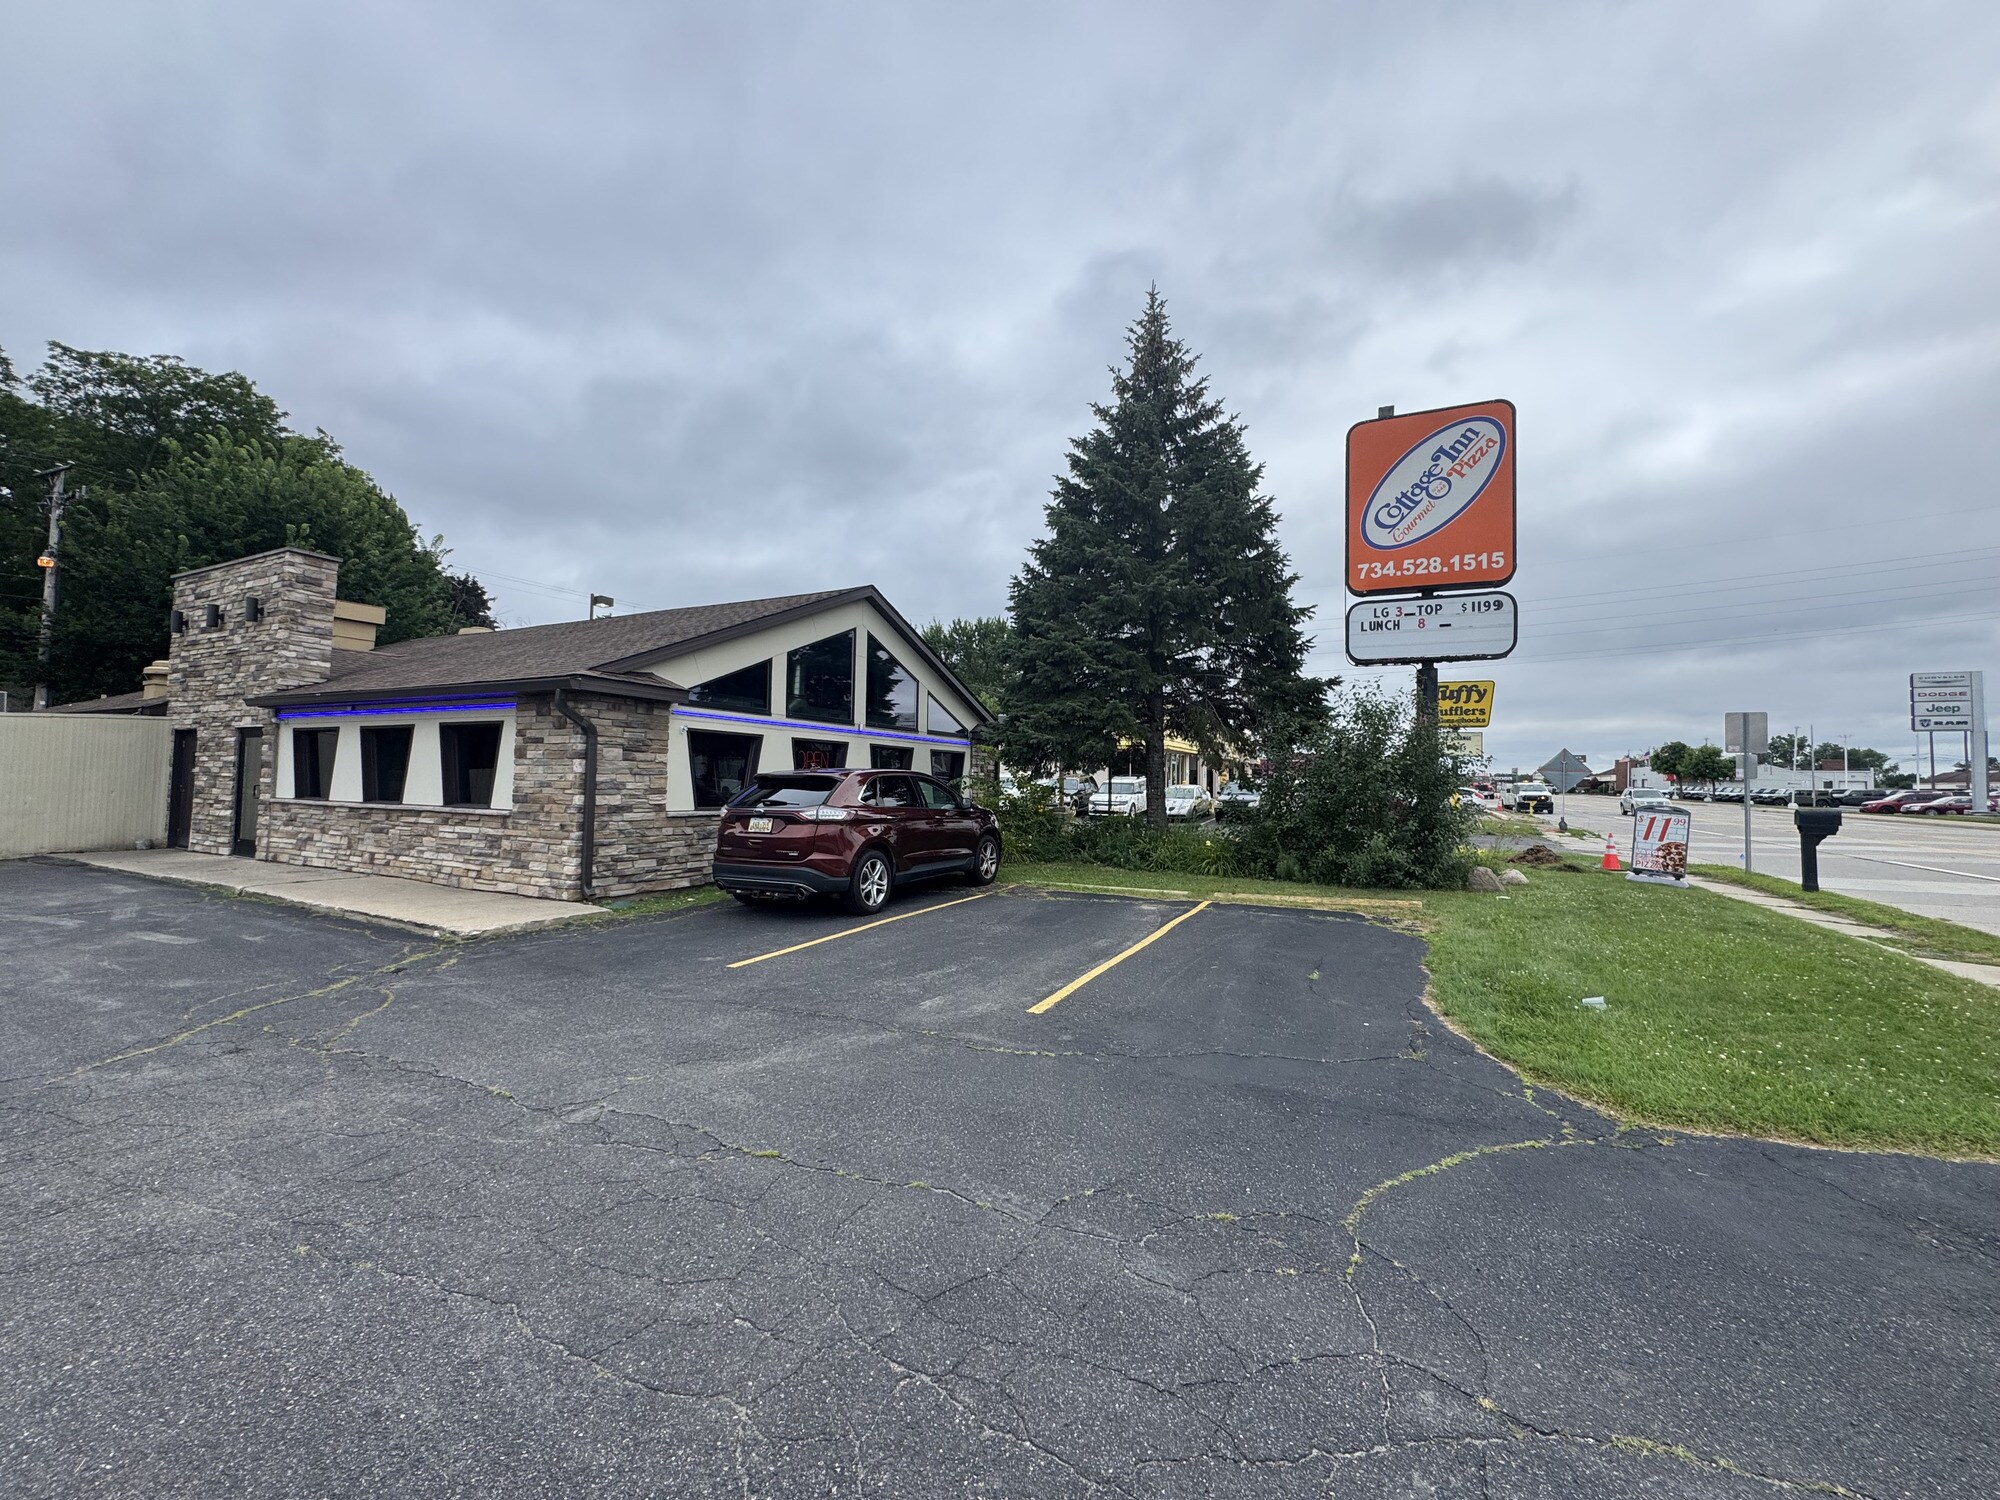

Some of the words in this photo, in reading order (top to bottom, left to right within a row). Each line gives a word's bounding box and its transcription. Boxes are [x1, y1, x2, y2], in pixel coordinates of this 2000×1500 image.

[1446, 437, 1499, 479] Pizza
[1374, 463, 1452, 531] Cottage
[1431, 427, 1481, 464] Inn
[1392, 500, 1436, 543] Gourmet
[1357, 551, 1505, 580] 734.528.1515
[1373, 607, 1390, 619] LG
[1360, 619, 1401, 632] LUNCH
[1417, 618, 1426, 629] 8
[1439, 706, 1486, 716] ufflers
[1926, 703, 1961, 713] Jeep
